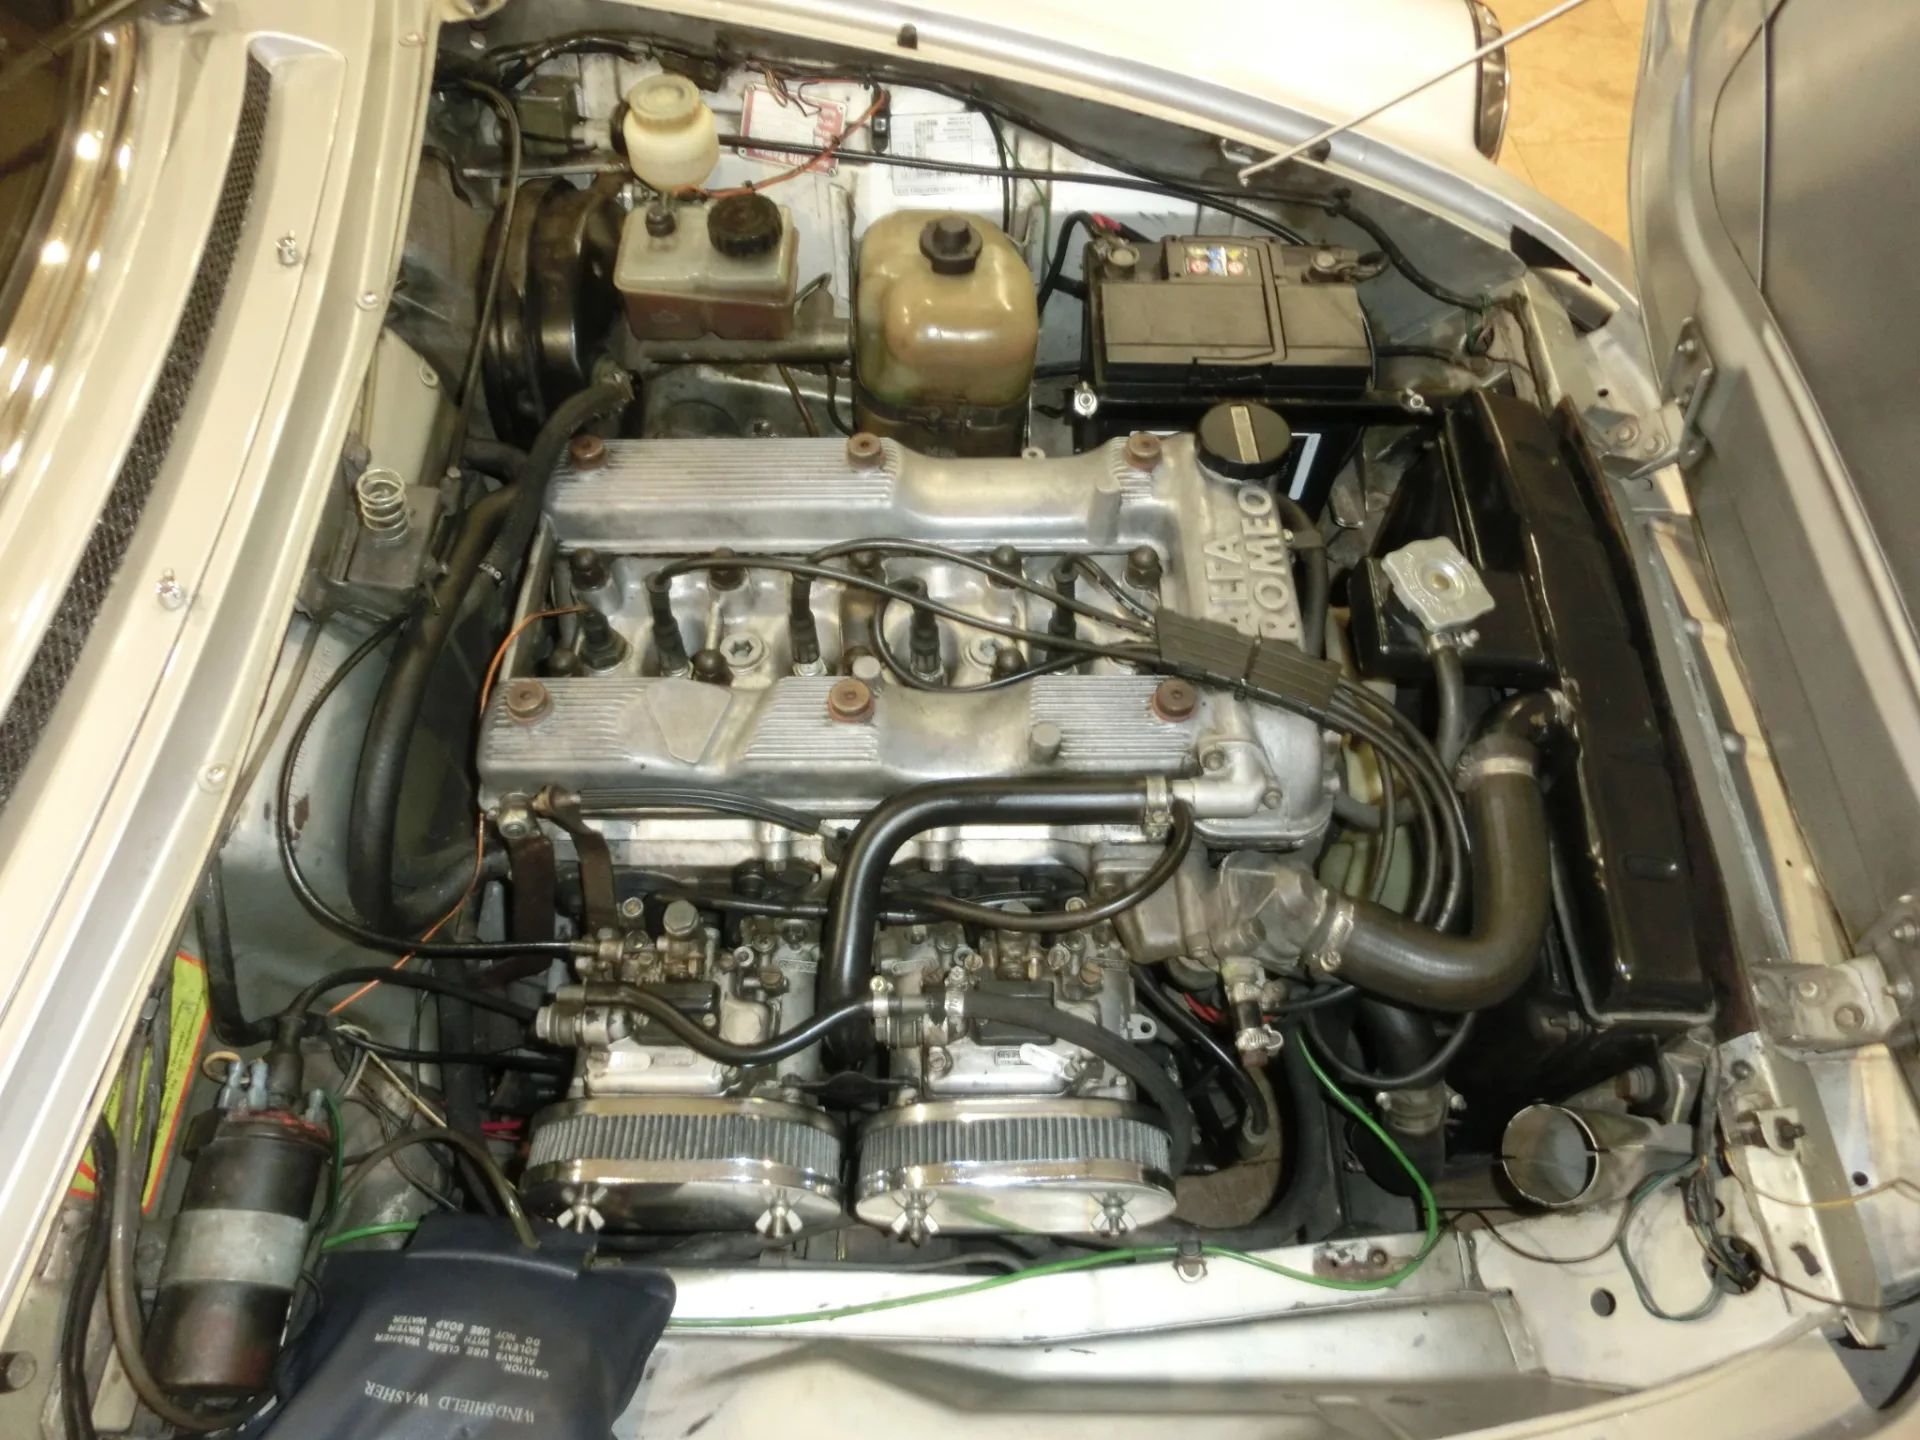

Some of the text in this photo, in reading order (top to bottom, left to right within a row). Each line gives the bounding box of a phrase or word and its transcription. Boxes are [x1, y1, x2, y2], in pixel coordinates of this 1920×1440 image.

[1237, 484, 1299, 642] ROMEO
[1203, 533, 1250, 634] ALFA
[387, 1324, 425, 1336] WATER
[392, 1315, 541, 1347] DO NOT USE SOAP WATER
[428, 1327, 457, 1343] PURE
[464, 1335, 490, 1347] WITH
[374, 1333, 536, 1366] ALWAYS USE CLEAR WASHER
[364, 1380, 535, 1424] WINDSHIELD WASHER
